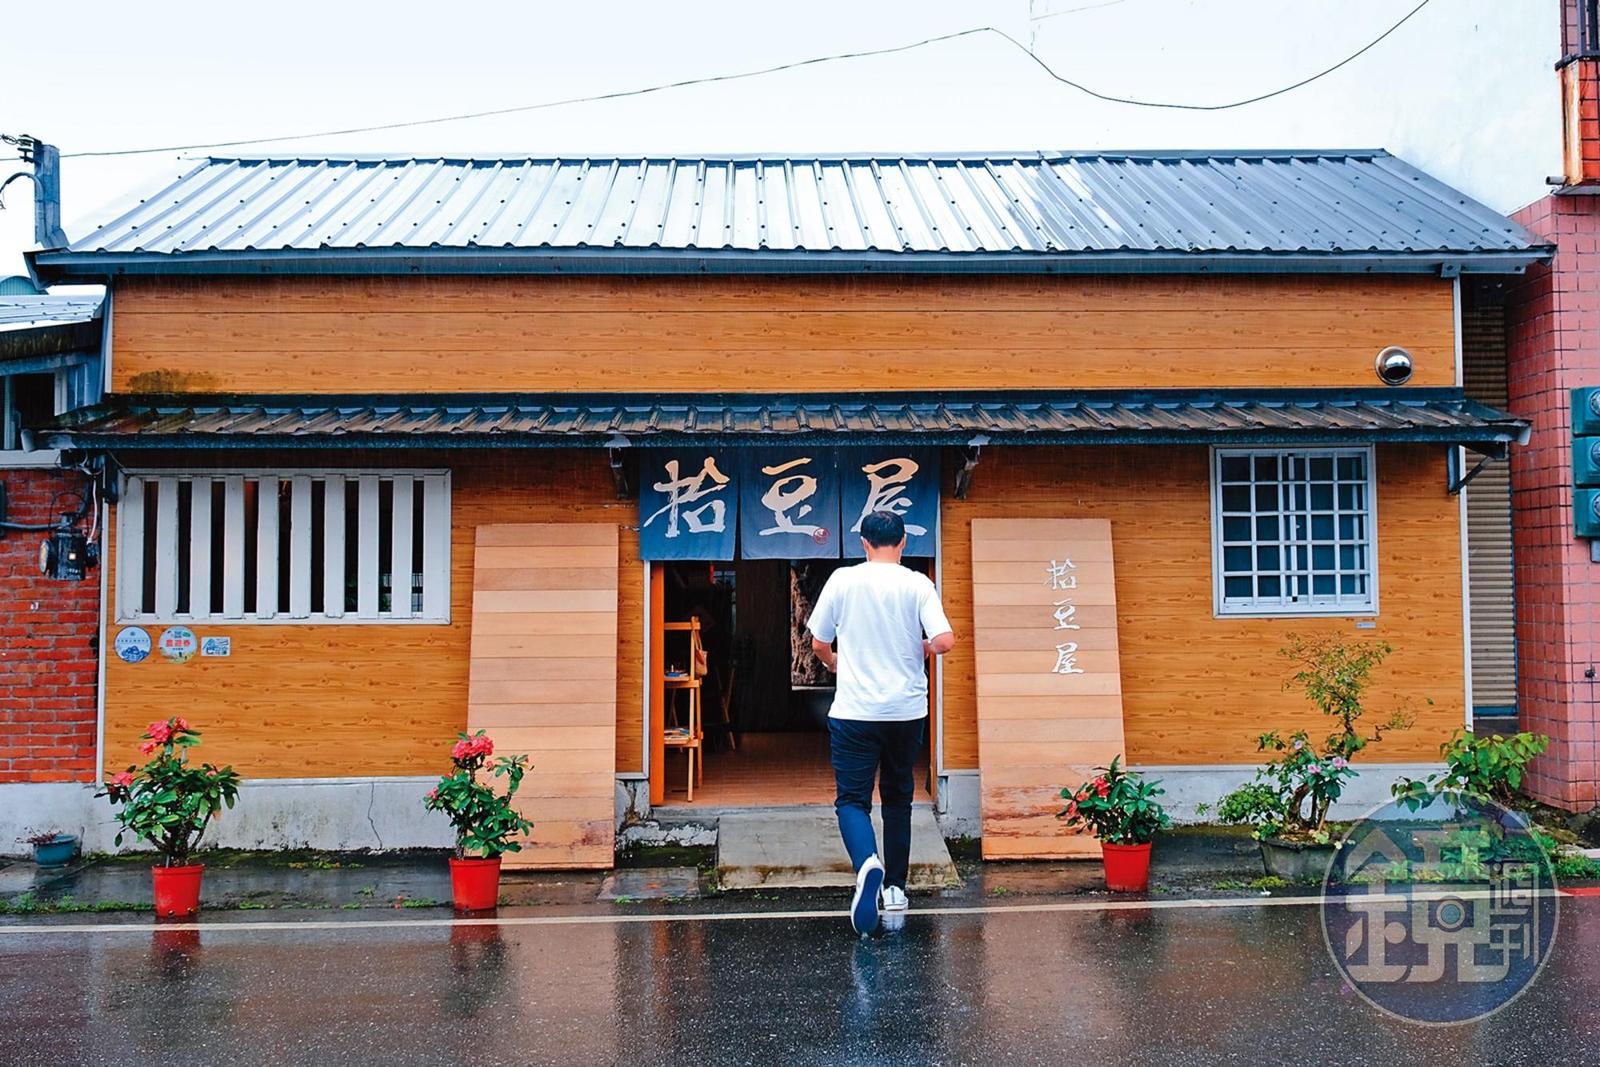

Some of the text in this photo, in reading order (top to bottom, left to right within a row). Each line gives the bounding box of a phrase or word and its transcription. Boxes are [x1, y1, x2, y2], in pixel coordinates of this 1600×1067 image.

[643, 456, 928, 538] 拾豆屋
[1043, 558, 1084, 673] 拾豆屋
